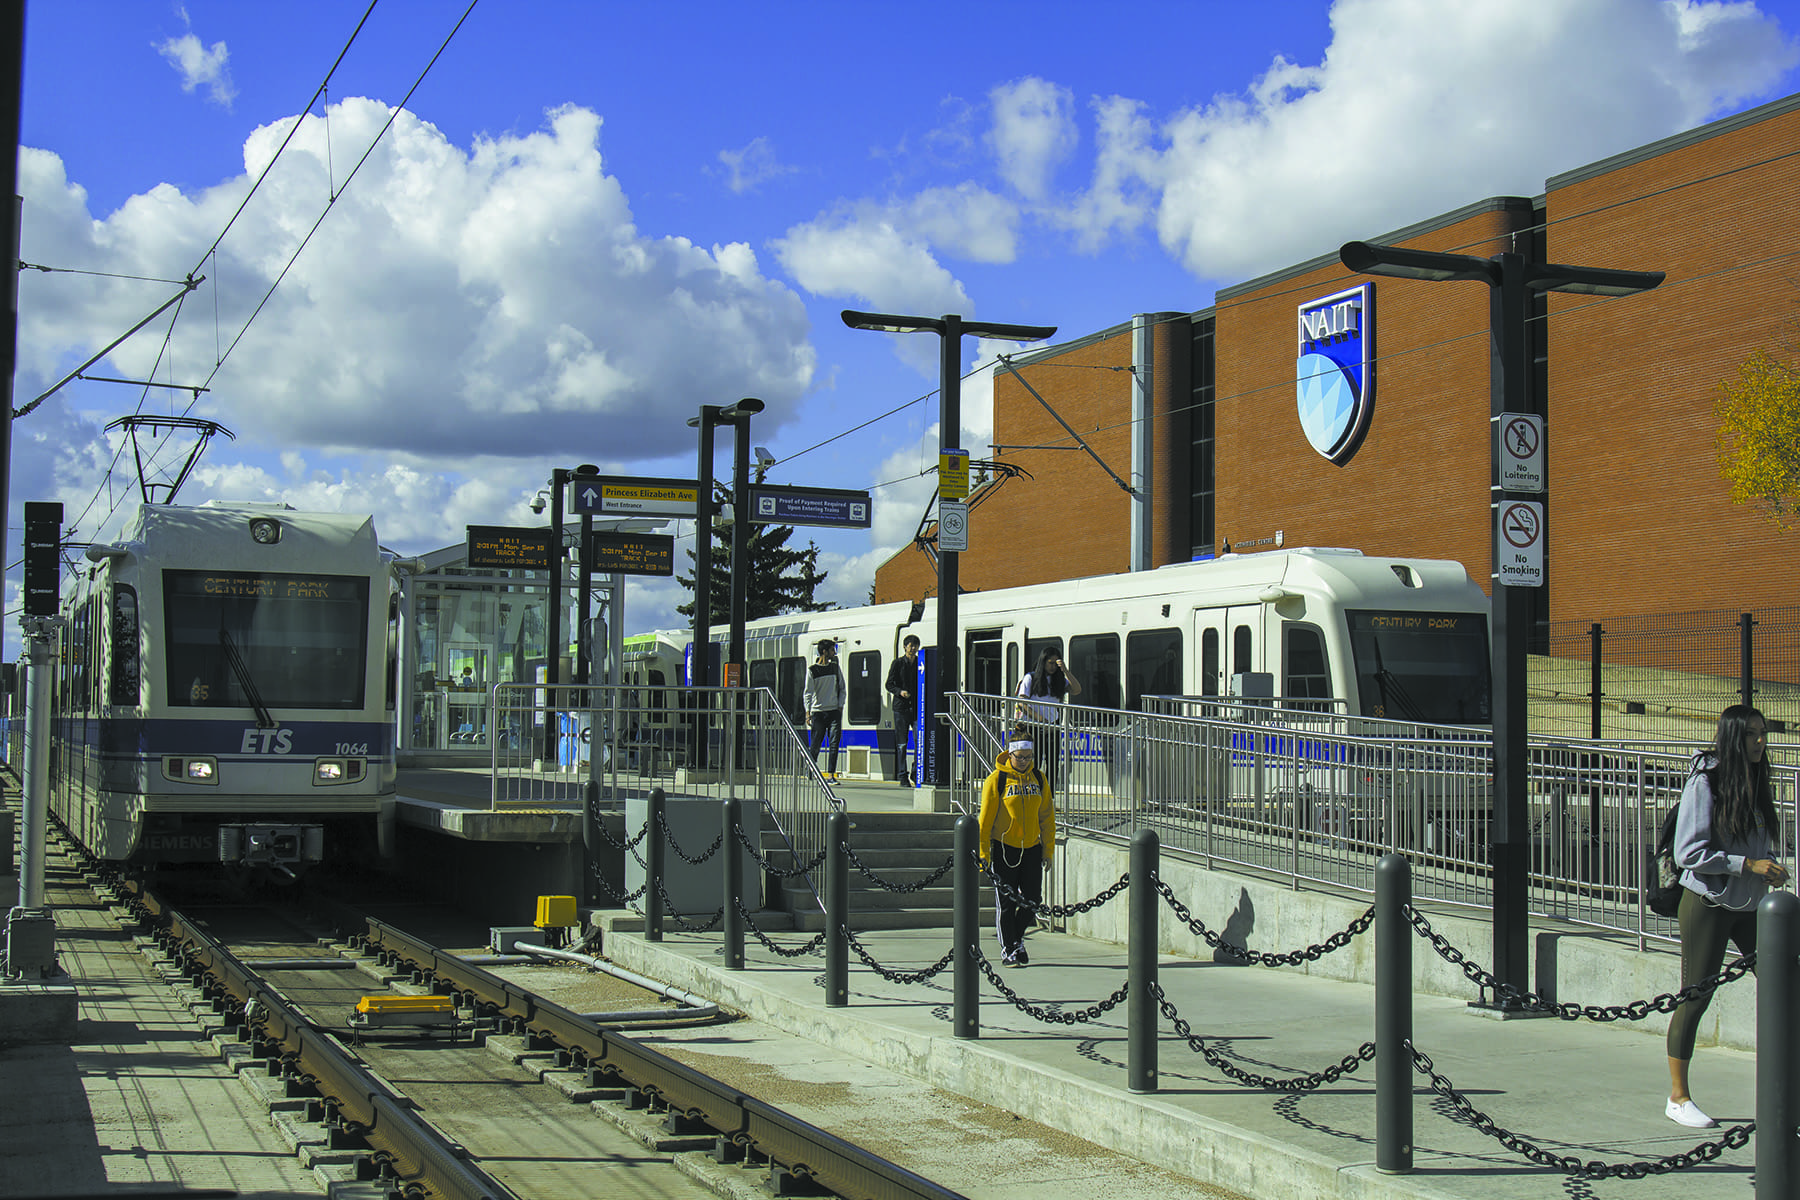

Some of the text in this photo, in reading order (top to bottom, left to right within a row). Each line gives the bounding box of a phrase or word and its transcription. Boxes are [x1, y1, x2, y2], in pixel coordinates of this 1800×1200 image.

[1300, 300, 1358, 343] NAIT
[1505, 471, 1539, 482] Loitering
[606, 488, 692, 499] Princess Elizabeth Ave
[1515, 554, 1527, 563] No
[1502, 565, 1540, 577] Smoking
[205, 577, 328, 597] CENTURY PARK
[1372, 617, 1458, 629] CENTURY PARK
[240, 729, 293, 754] ETS
[335, 742, 368, 755] 1064
